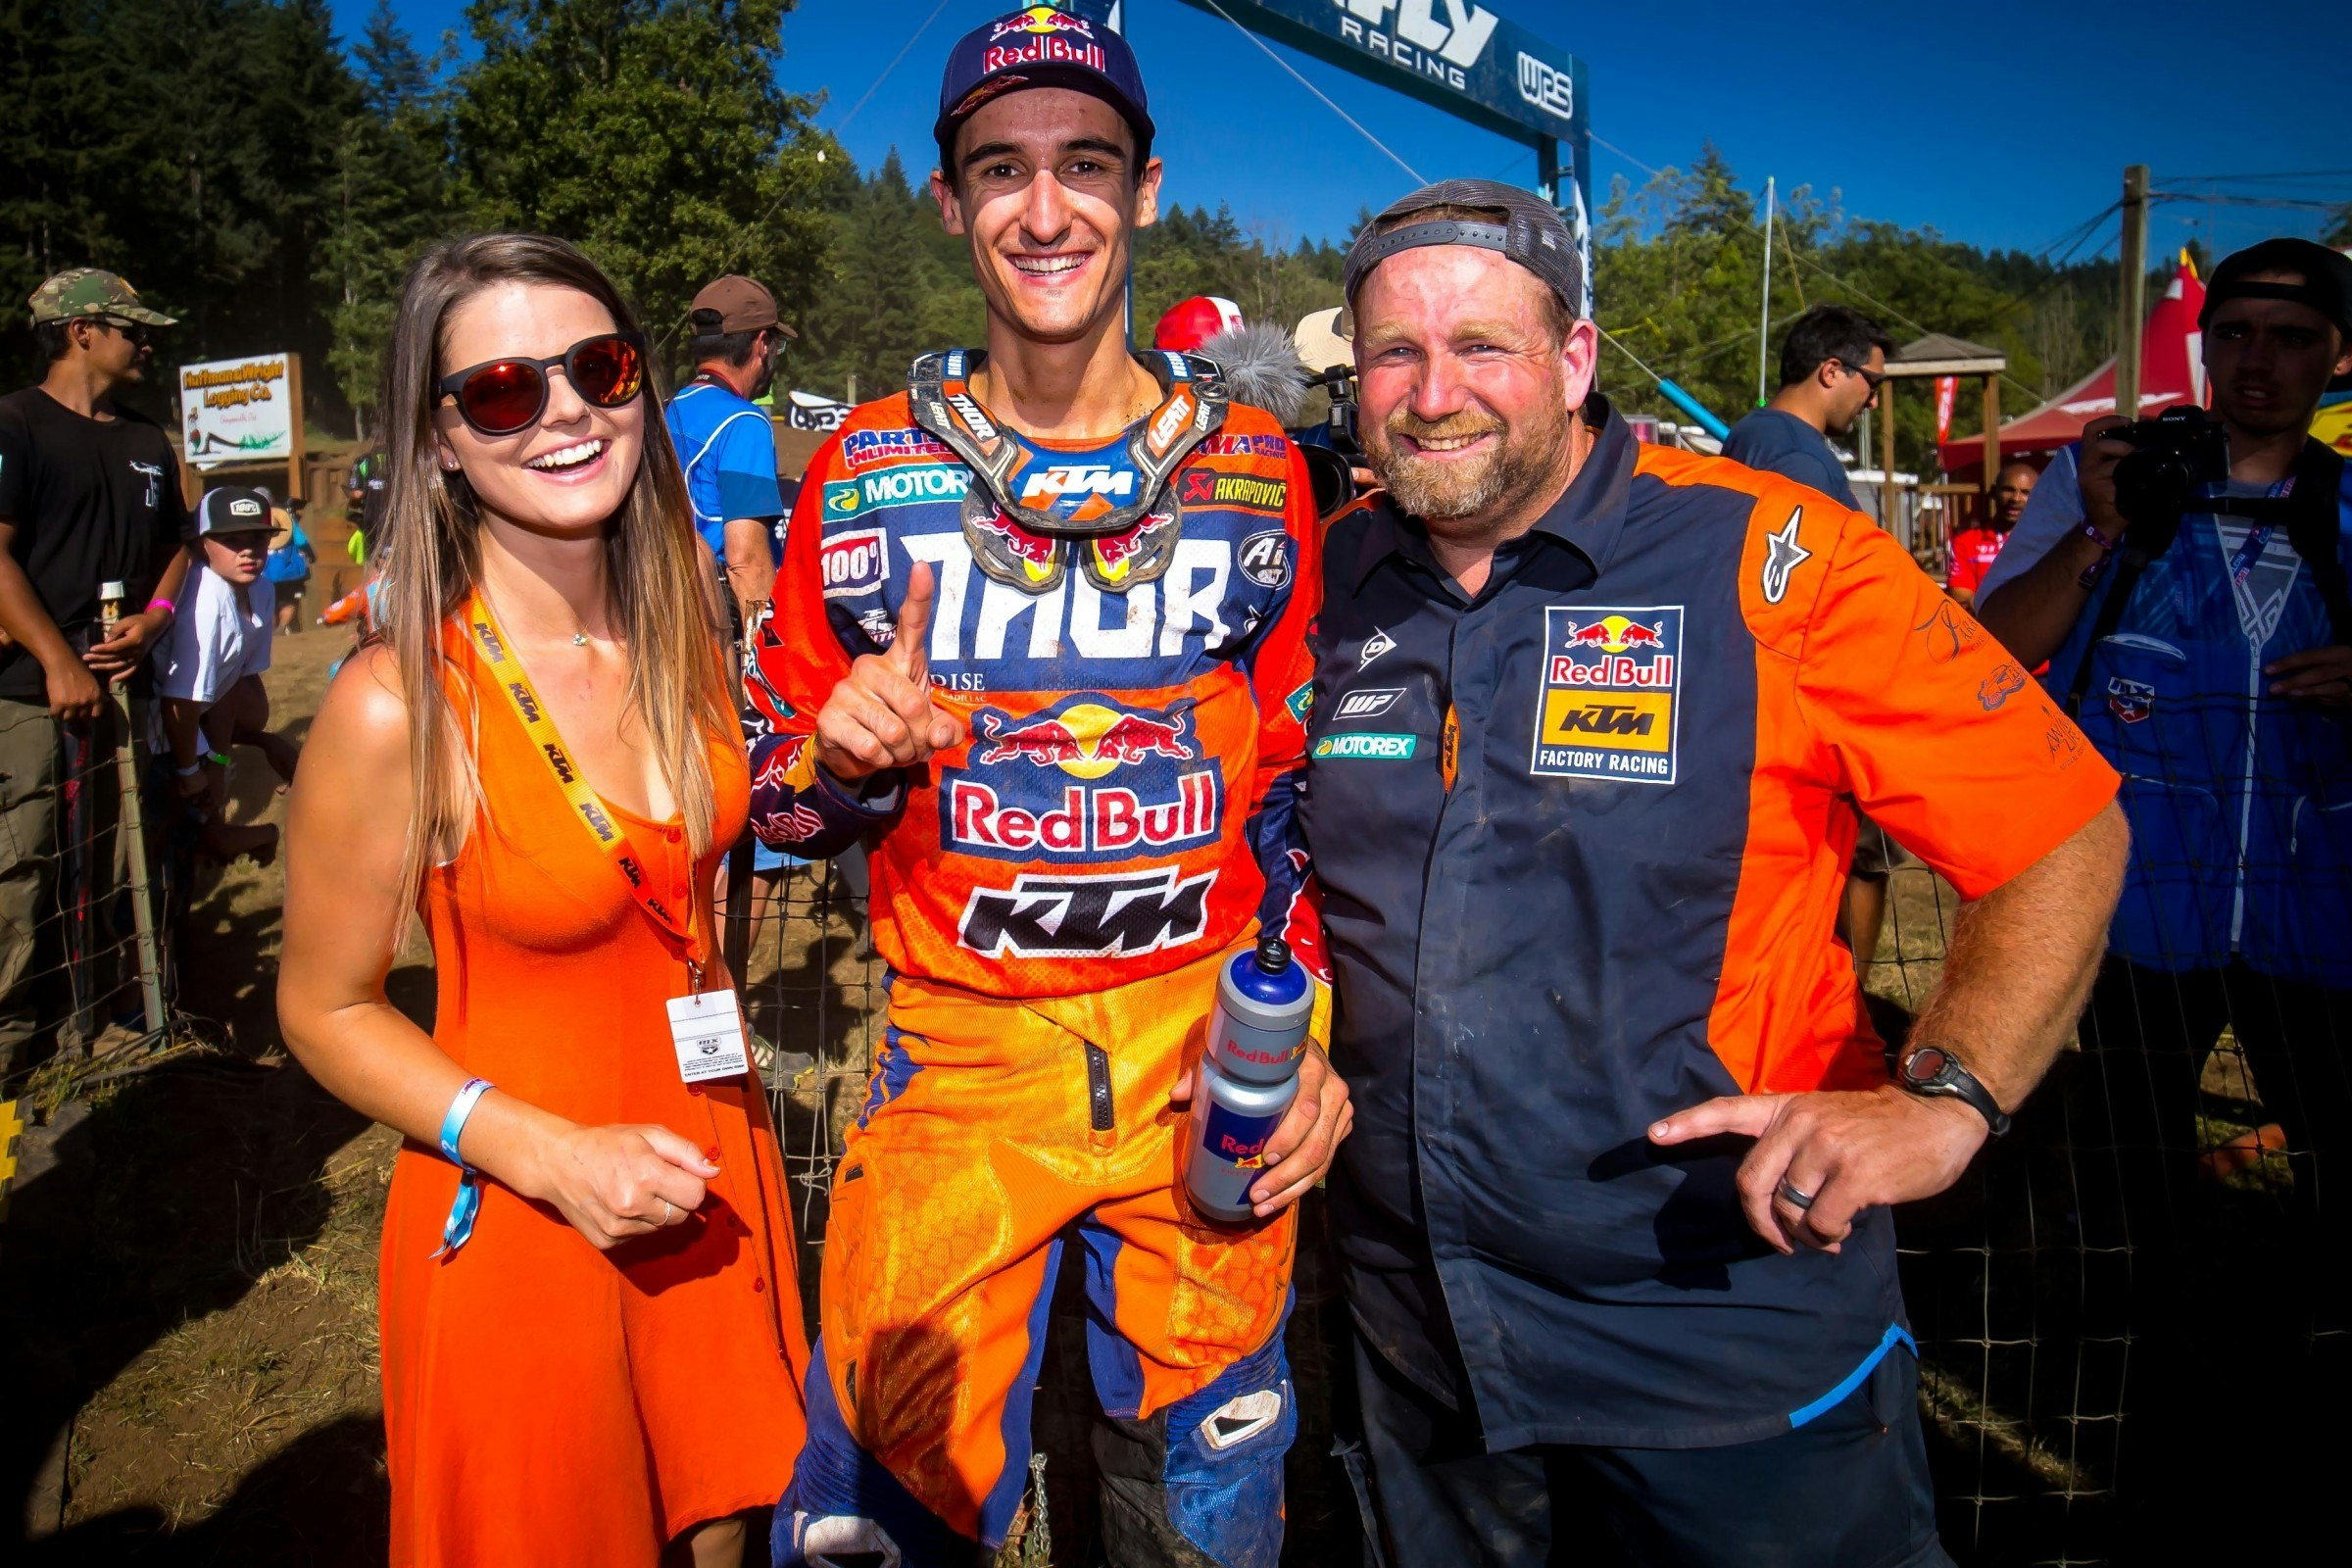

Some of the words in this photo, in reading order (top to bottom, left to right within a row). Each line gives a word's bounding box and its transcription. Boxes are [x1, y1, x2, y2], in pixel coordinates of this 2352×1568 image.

[983, 35, 1046, 74] Red
[1047, 36, 1105, 73] Bull
[1341, 16, 1466, 90] RACING
[1517, 51, 1573, 121] WPS
[204, 386, 249, 409] Logging
[929, 401, 952, 430] LEATT
[947, 394, 996, 441] THOR
[1151, 394, 1191, 449] LEATT
[1195, 400, 1211, 432] LEATT
[1251, 435, 1286, 452] PRO
[1254, 447, 1287, 460] RACING
[865, 469, 974, 504] MOTOR
[1021, 465, 1134, 498] KTM
[235, 503, 258, 513] 100%
[900, 532, 1231, 661] THOR
[473, 621, 506, 663] KTM
[1550, 655, 1609, 685] Red
[1612, 654, 1674, 687] Bull
[508, 682, 540, 724] KTM
[1340, 694, 1394, 714] WP
[1558, 704, 1655, 736] KTM
[1331, 736, 1409, 757] MOTOREX
[1540, 750, 1605, 769] FACTORY
[1608, 754, 1668, 775] RACING
[542, 743, 574, 784] KTM
[578, 802, 613, 842] KTM
[952, 779, 1084, 853] Red
[1092, 770, 1215, 853] Bull
[618, 857, 642, 889] KTM
[646, 897, 673, 925] KTM
[957, 865, 1220, 958] KTM
[1227, 1039, 1257, 1063] Red
[1258, 1049, 1290, 1065] Bull
[1220, 1134, 1265, 1155] Red
